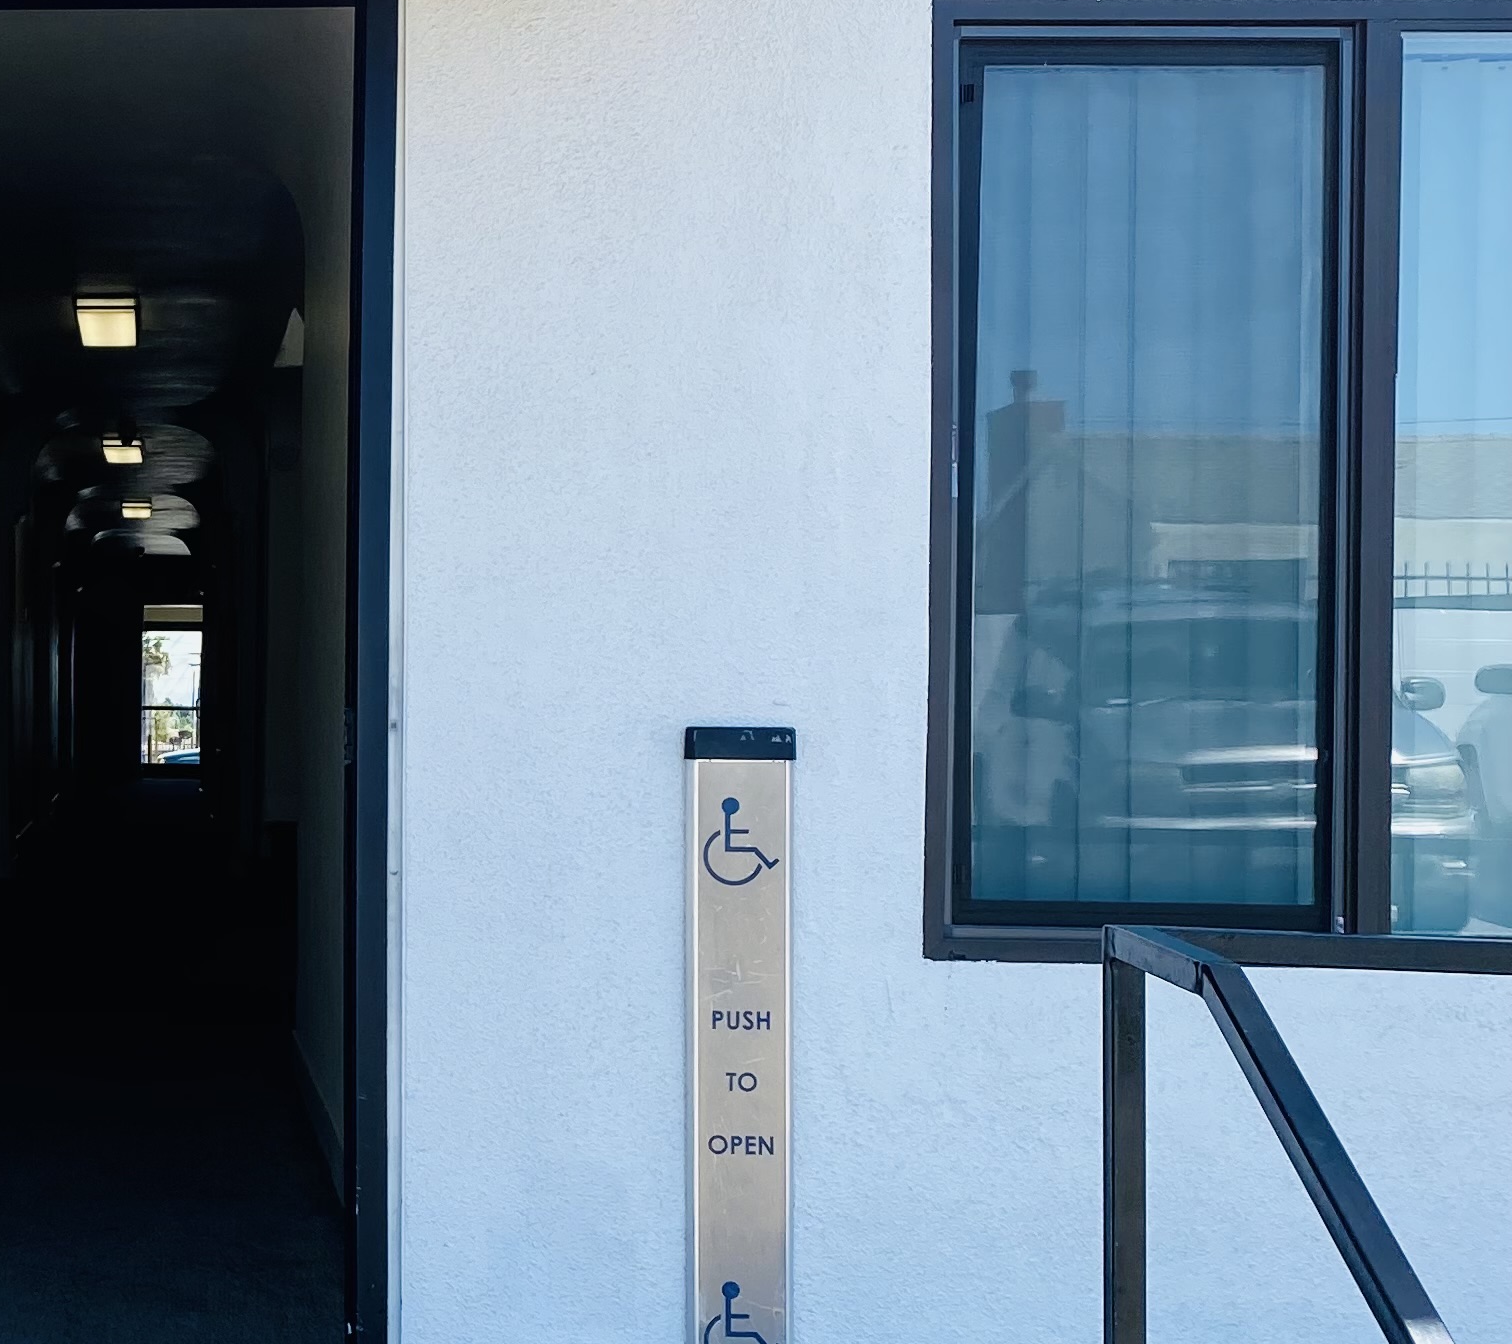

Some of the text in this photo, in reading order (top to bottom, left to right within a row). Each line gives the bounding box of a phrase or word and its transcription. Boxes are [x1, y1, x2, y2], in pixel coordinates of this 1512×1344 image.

[711, 1010, 771, 1030] PUSH
[725, 1072, 757, 1092] TO
[708, 1135, 774, 1155] OPEN
